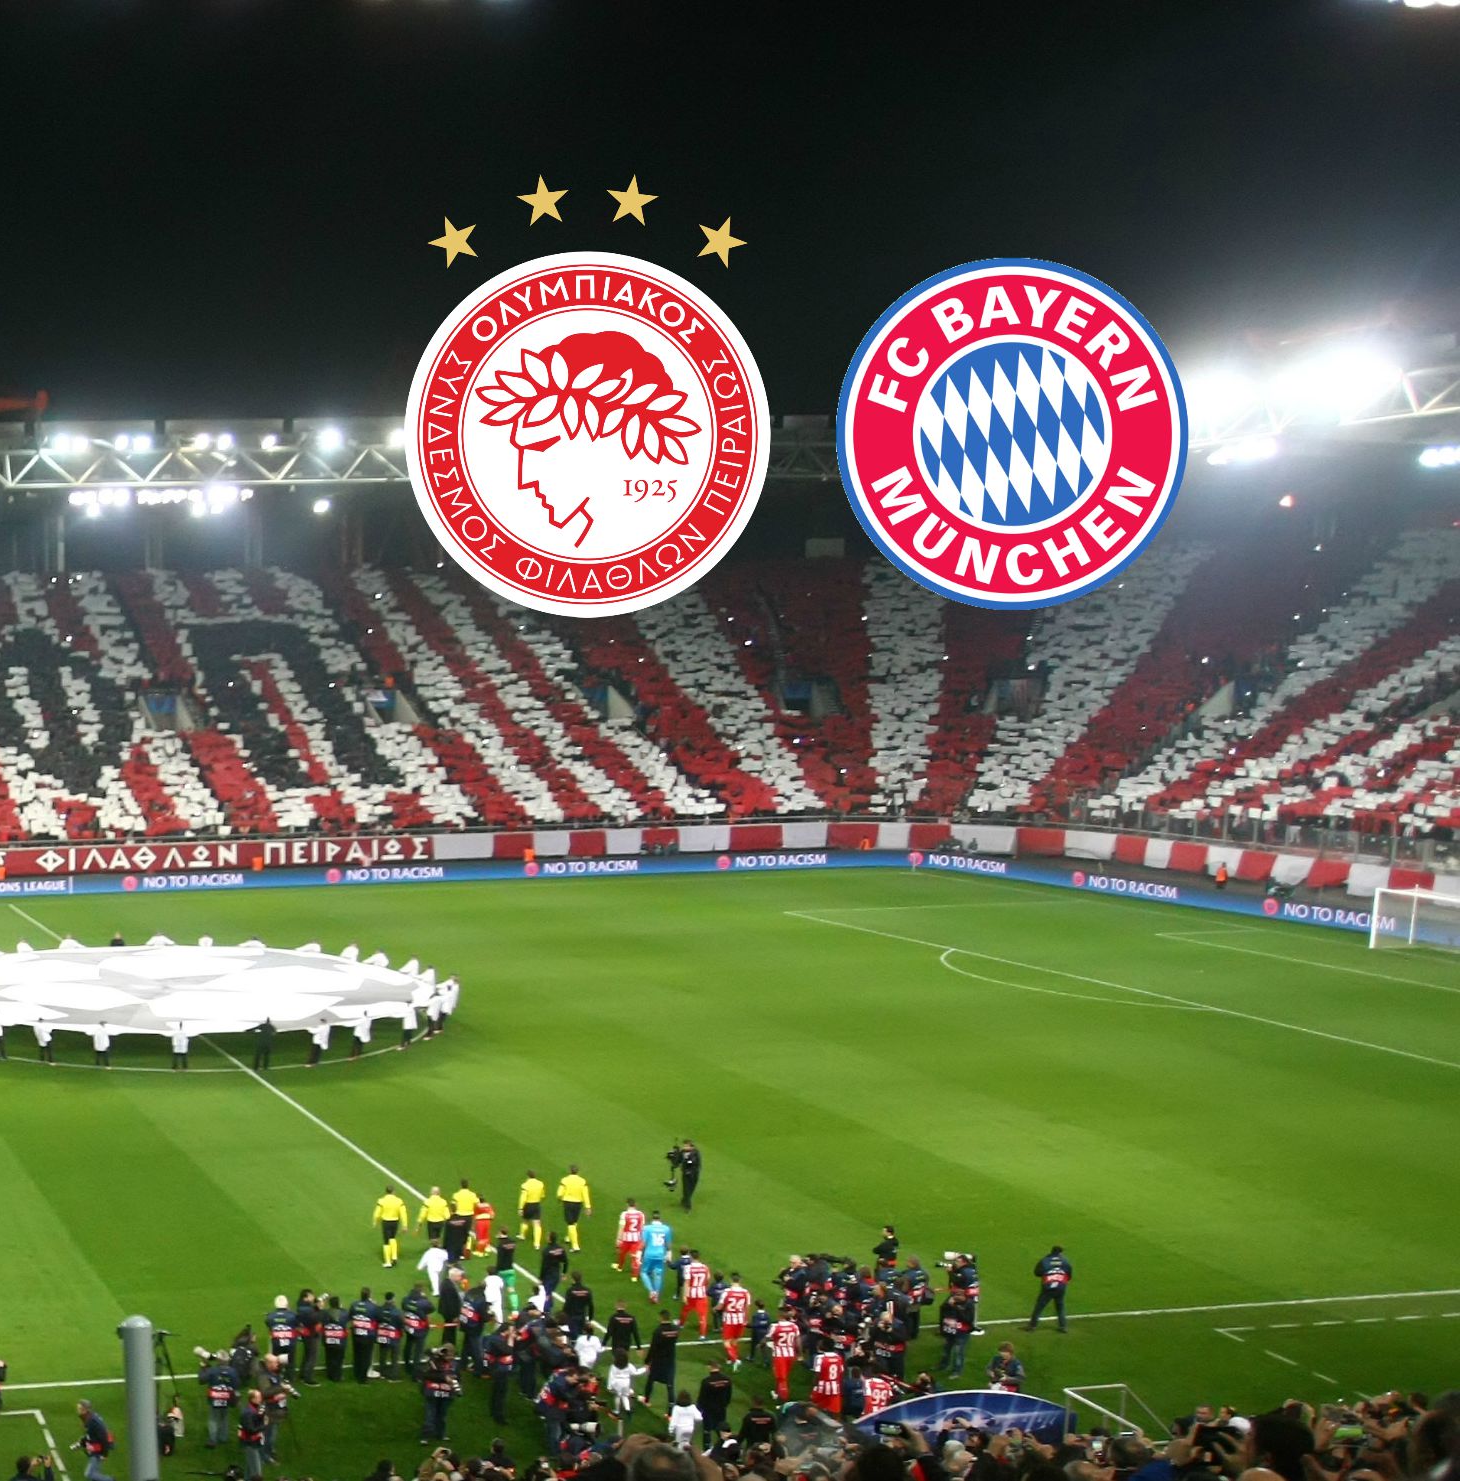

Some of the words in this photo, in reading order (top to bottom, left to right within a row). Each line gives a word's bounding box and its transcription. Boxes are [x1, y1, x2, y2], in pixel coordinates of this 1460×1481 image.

[35, 843, 238, 872] ΦΙΛΑΘΛΩΝ
[264, 837, 429, 865] ΠΕΙΡΑΙΩΣ
[735, 856, 756, 868] NO
[758, 855, 779, 867] TO
[780, 853, 827, 866] RACISM
[544, 862, 566, 874] NO
[568, 861, 588, 873] TO
[589, 859, 638, 872] RACISM
[928, 854, 950, 867] NO
[950, 856, 966, 868] TO
[967, 858, 1006, 873] RACISM
[143, 876, 167, 888] NO
[169, 875, 188, 887] TO
[191, 873, 244, 886] RACISM
[346, 870, 370, 881] NO
[371, 868, 390, 880] TO
[393, 867, 444, 878] RACISM
[23, 880, 67, 892] LEAGUE
[1089, 876, 1108, 890] NO
[1110, 877, 1127, 892] TO
[1129, 880, 1178, 899] RACISM
[1284, 902, 1309, 919] NO
[1310, 906, 1332, 922] TO
[727, 1298, 746, 1312] 24
[777, 1332, 796, 1347] 20
[828, 1364, 838, 1380] 8
[871, 1389, 888, 1406] 99
